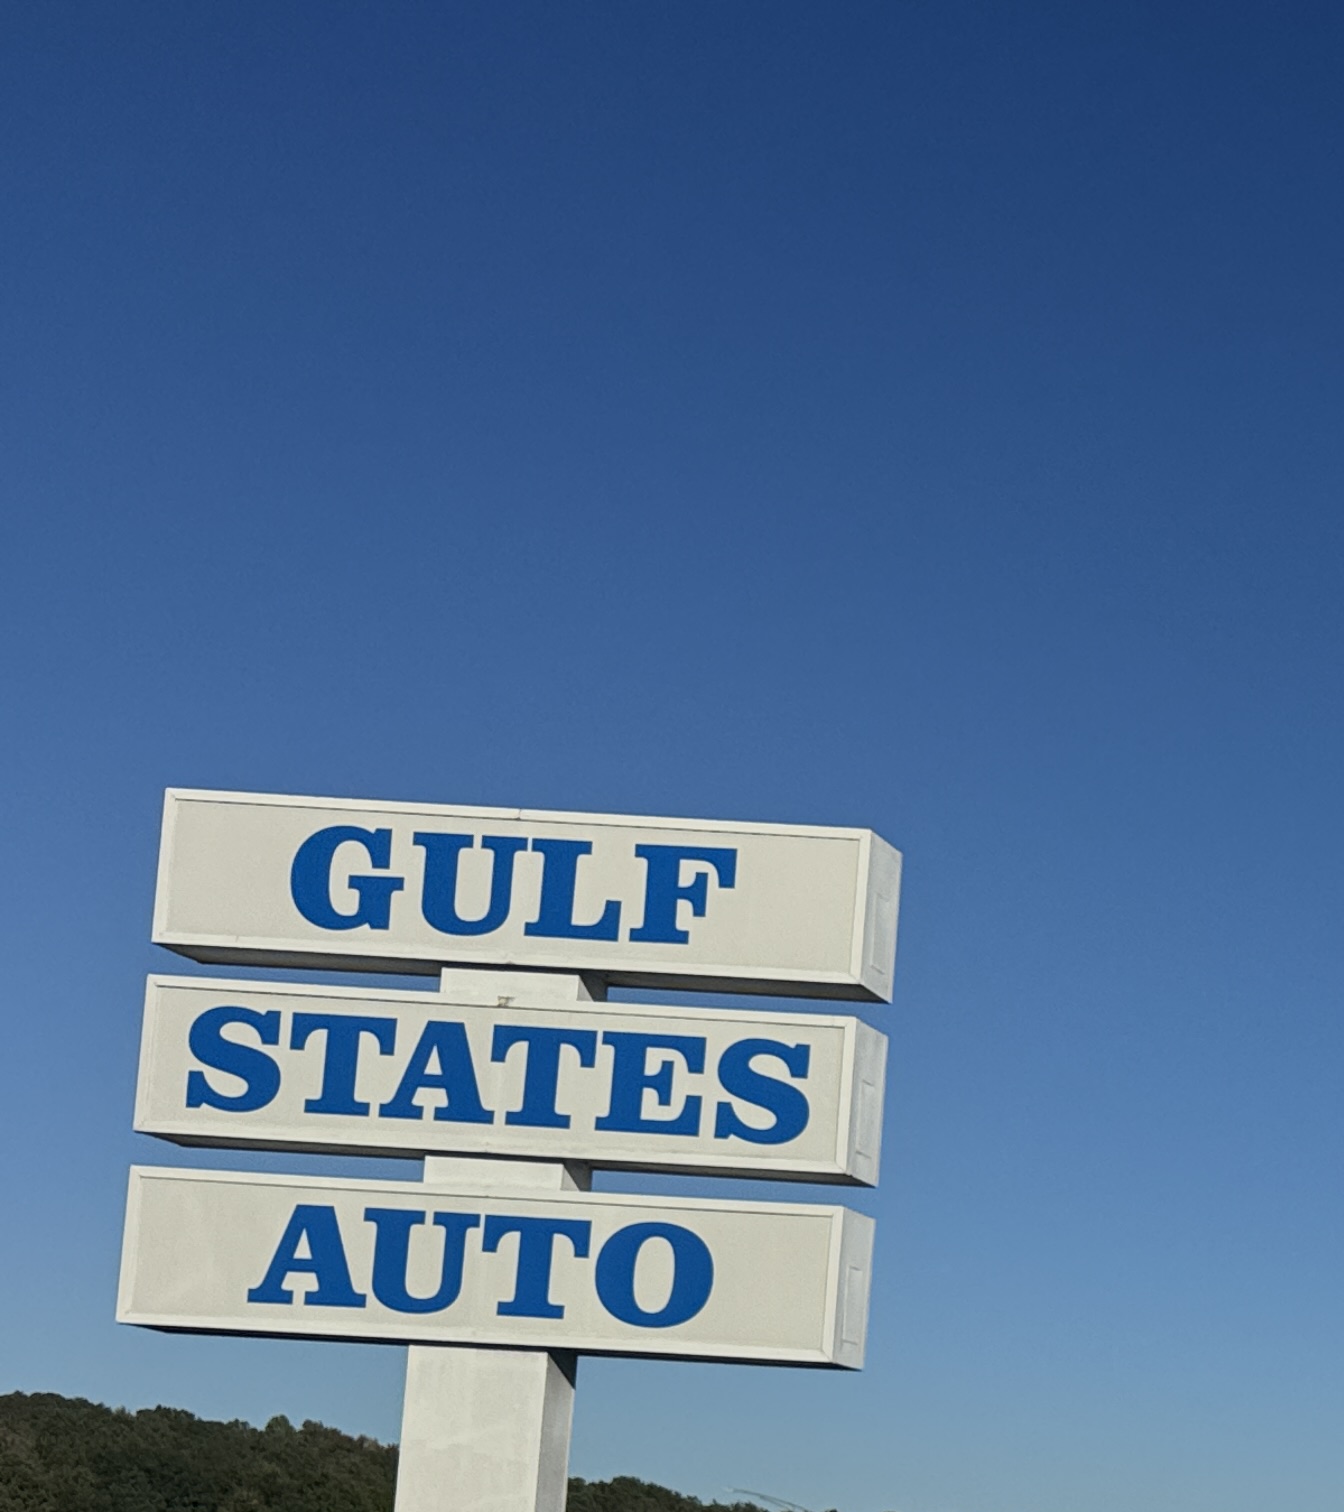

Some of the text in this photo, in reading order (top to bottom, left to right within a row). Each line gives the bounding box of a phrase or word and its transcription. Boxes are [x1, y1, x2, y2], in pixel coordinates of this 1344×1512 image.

[290, 825, 738, 945] GULF
[186, 1006, 811, 1145] STATES
[246, 1204, 714, 1328] AUTO
